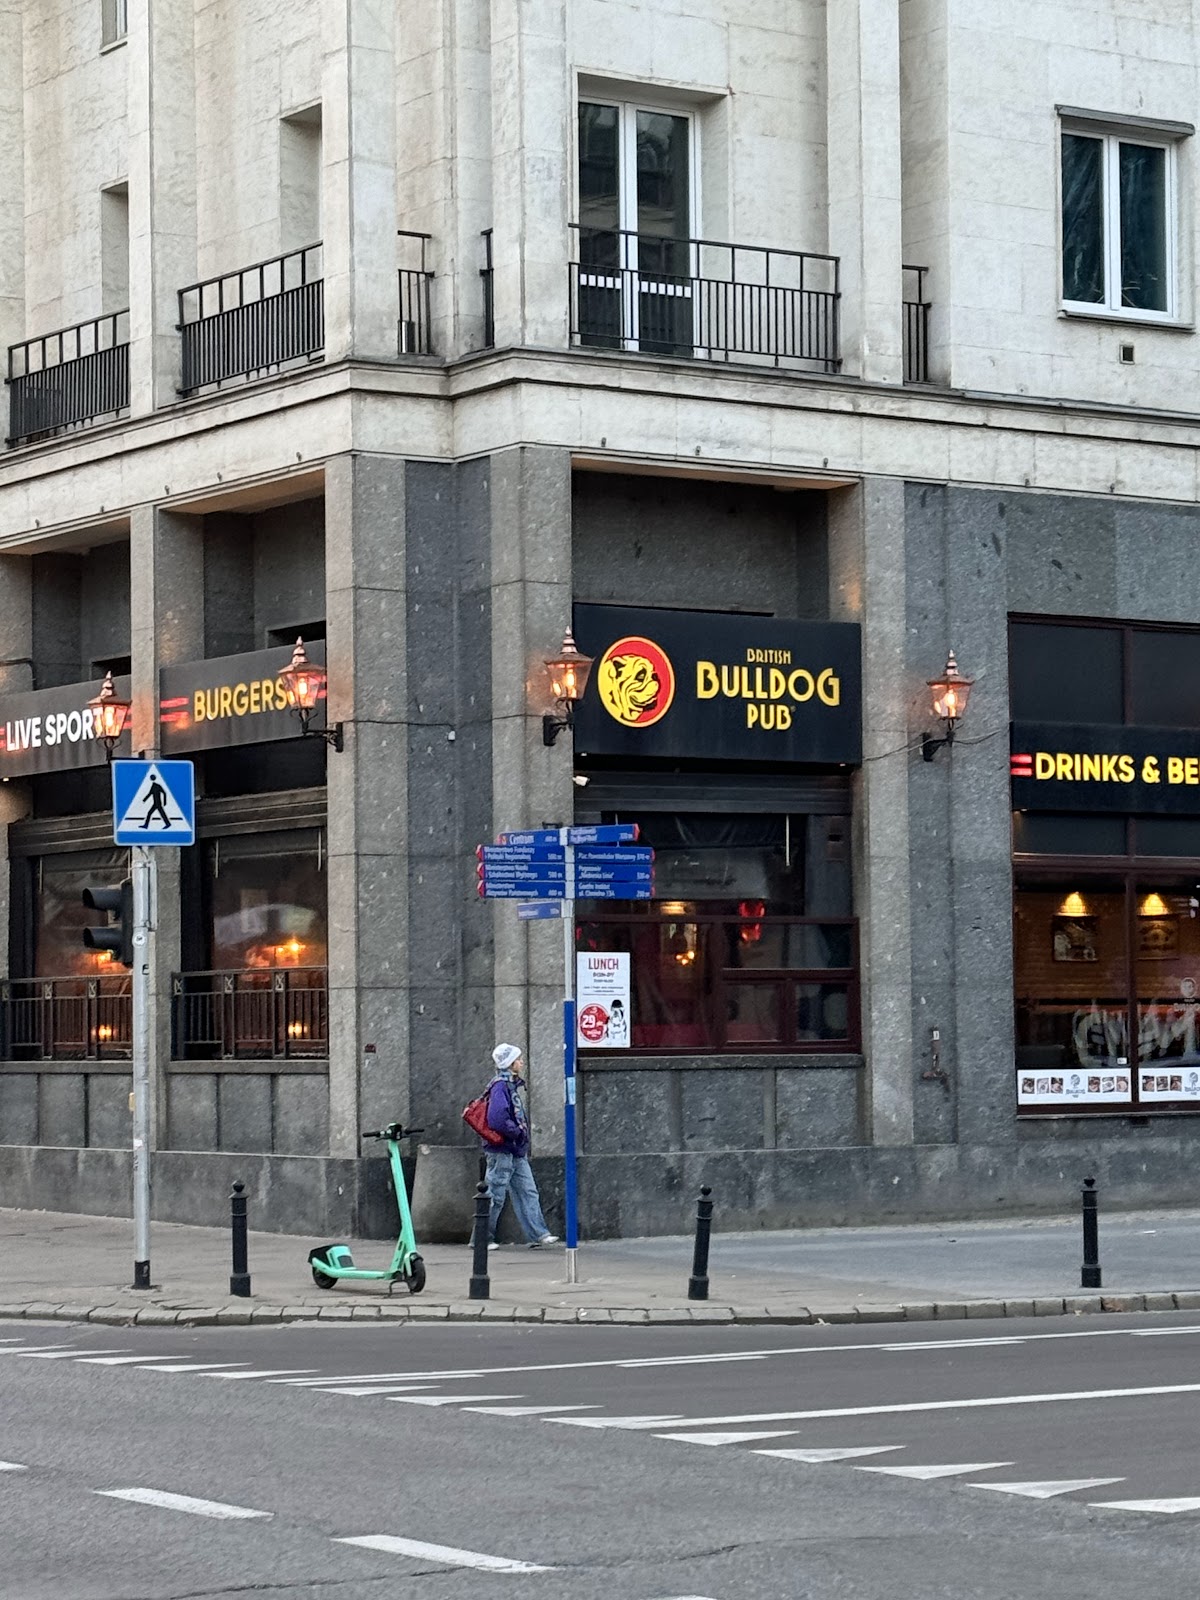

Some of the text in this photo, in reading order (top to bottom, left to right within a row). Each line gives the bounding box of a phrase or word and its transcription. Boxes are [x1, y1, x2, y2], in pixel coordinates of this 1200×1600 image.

[747, 648, 791, 664] BRITISH
[696, 661, 840, 706] BULLDOG
[193, 678, 288, 722] BURGERS
[747, 703, 792, 730] PUB
[6, 715, 42, 752] LIVE
[1035, 752, 1200, 785] DRINKS & BE
[588, 958, 619, 970] LUNCH
[582, 1014, 596, 1029] 29
